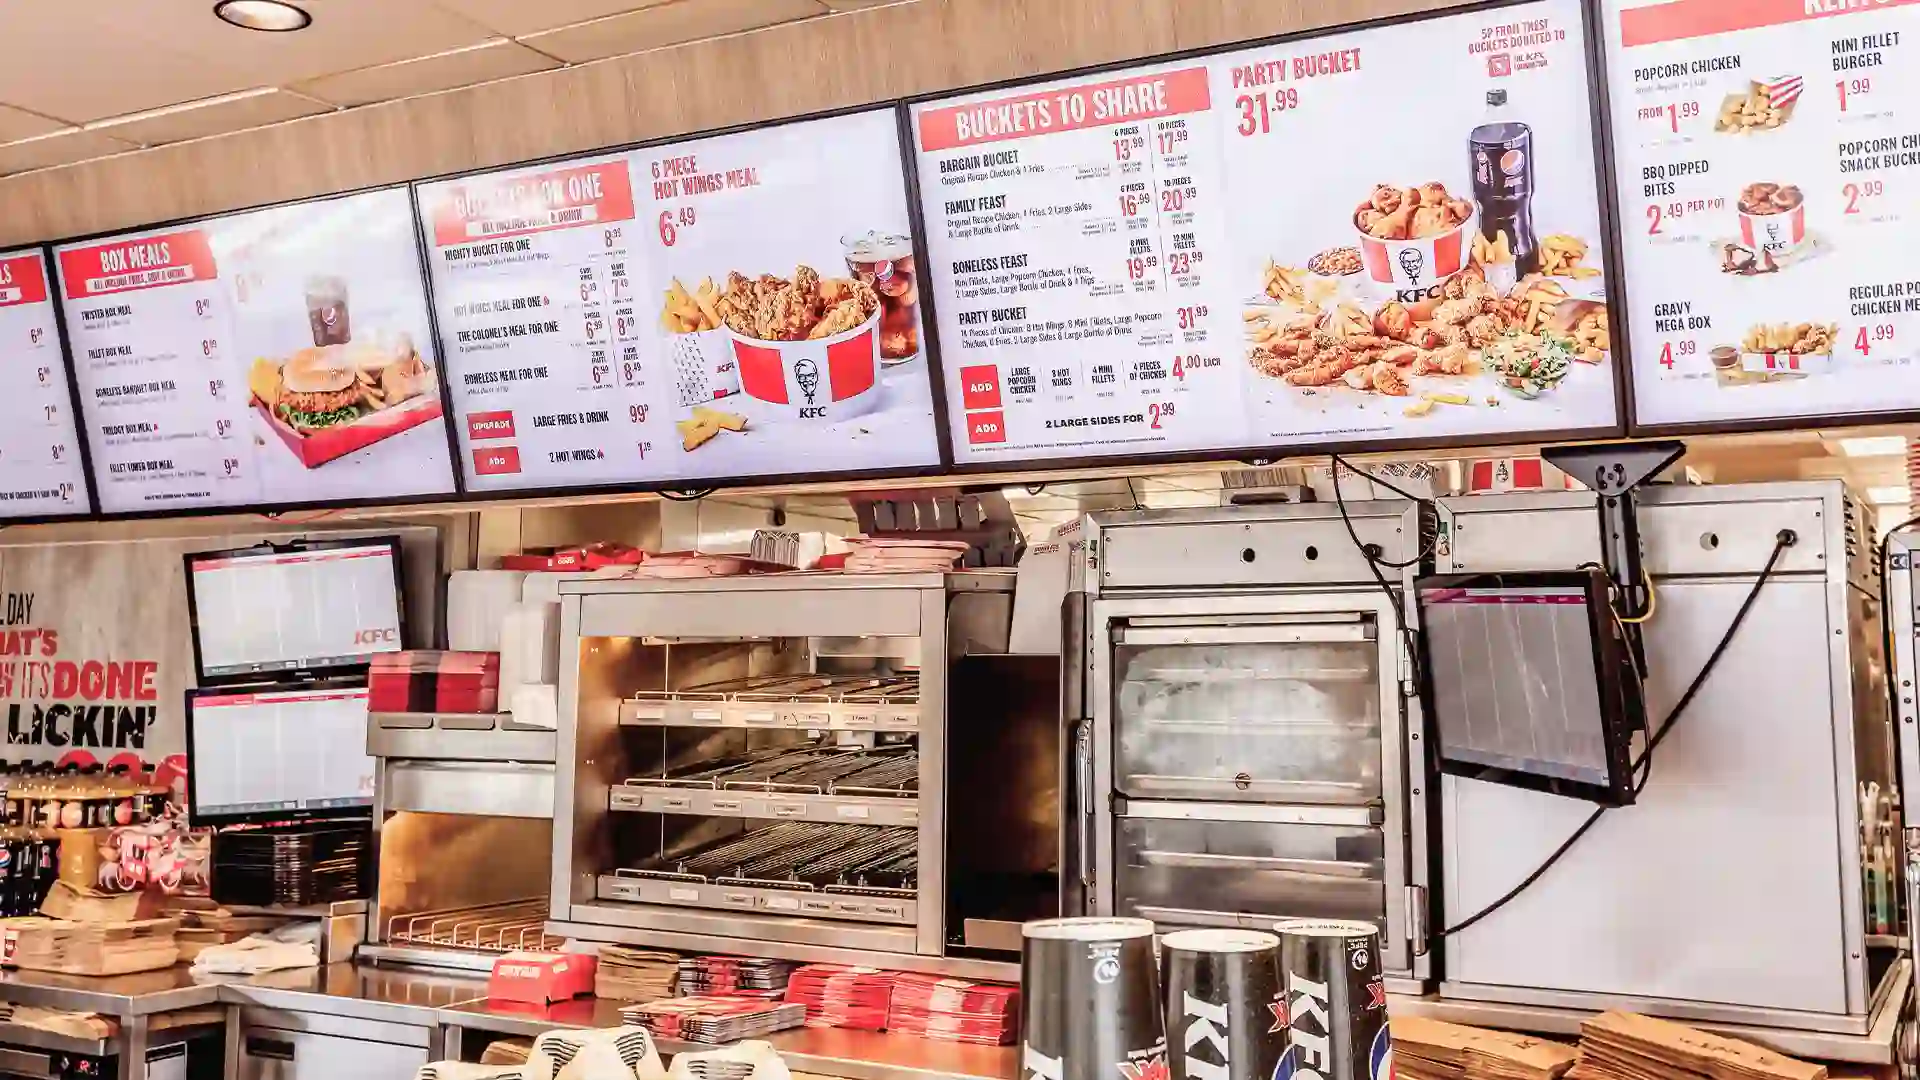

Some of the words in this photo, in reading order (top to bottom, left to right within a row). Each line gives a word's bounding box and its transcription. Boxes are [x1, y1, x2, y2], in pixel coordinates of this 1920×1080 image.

[1496, 24, 1519, 37] FROM
[1468, 38, 1509, 54] BUCKETS
[1510, 32, 1552, 48] DONATED
[1554, 30, 1565, 41] TO
[1831, 37, 1858, 54] MINI
[1862, 31, 1900, 50] FILLET
[1230, 60, 1286, 88] PARTY
[1293, 48, 1361, 80] BUCKET
[1635, 62, 1688, 82] POPCORN
[1692, 55, 1741, 74] CHICKEN
[1832, 52, 1883, 71] BURGER
[1835, 78, 1870, 111] 1.99
[956, 99, 1052, 140] BUCKETS
[1057, 94, 1086, 125] TO
[1093, 80, 1168, 119] SHARE
[1236, 88, 1298, 137] 31.99
[1638, 106, 1663, 120] FROM
[1667, 101, 1700, 133] 1.99
[1157, 122, 1165, 131] 10
[1165, 120, 1186, 130] PIECES
[1112, 137, 1144, 160] 13.99
[1157, 130, 1188, 154] 17.99
[1839, 136, 1897, 156] POPCORN
[652, 161, 660, 179] 6
[663, 155, 698, 177] PIECE
[940, 156, 980, 174] BARGAIN
[983, 150, 1019, 167] BUCKET
[1643, 165, 1665, 180] BBQ
[1668, 160, 1709, 177] DIPPED
[1840, 155, 1880, 173] SNACK
[568, 173, 604, 201] ONE
[654, 180, 678, 200] HOT
[682, 173, 723, 196] WINGS
[726, 168, 761, 189] MEAL
[1126, 183, 1145, 192] PIECES
[1172, 177, 1192, 186] PIECES
[1644, 182, 1675, 197] BITES
[945, 198, 976, 215] FAMILY
[979, 195, 1007, 211] FEAST
[1119, 193, 1150, 217] 16.99
[1162, 187, 1197, 211] 20.99
[1842, 180, 1883, 214] 2.99
[1646, 202, 1683, 235] 2.49
[1687, 200, 1705, 212] PER
[1707, 198, 1725, 210] POT
[659, 207, 696, 247] 6.49
[101, 250, 127, 273] BOX
[129, 242, 171, 268] MEALS
[445, 247, 471, 261] MIGHTY
[472, 244, 499, 257] BUCKET
[500, 241, 515, 253] FOR
[516, 239, 531, 251] ONE
[952, 258, 998, 274] BONELESS
[1000, 254, 1028, 269] FEAST
[1126, 256, 1157, 280] 19.99
[1170, 251, 1203, 274] 23.99
[1396, 285, 1441, 302] KFC
[1849, 283, 1903, 300] REGULAR
[470, 301, 491, 314] WINGS
[493, 299, 511, 312] MEAL
[512, 298, 526, 310] FOR
[528, 296, 541, 307] ONE
[1654, 301, 1691, 316] GRAVY
[1851, 299, 1901, 316] CHICKEN
[959, 310, 988, 325] PARTY
[991, 307, 1027, 321] BUCKET
[1176, 306, 1208, 329] 31.99
[1655, 317, 1684, 332] MEGA
[1688, 315, 1711, 330] BOX
[457, 330, 471, 343] THE
[472, 326, 508, 341] COLONEL'S
[509, 324, 528, 337] MEAL
[529, 322, 543, 335] FOR
[544, 321, 559, 333] ONE
[1064, 331, 1083, 341] Large
[1855, 324, 1894, 356] 4.99
[1659, 340, 1696, 370] 4.99
[464, 372, 499, 385] BONELESS
[499, 370, 517, 383] MEAL
[519, 367, 533, 380] FOR
[534, 366, 549, 378] ONE
[1011, 366, 1031, 377] LARGE
[1057, 368, 1070, 377] HOT
[1098, 365, 1113, 374] MINI
[1129, 372, 1138, 381] OF
[1139, 369, 1167, 380] CHICKEN
[1139, 361, 1161, 371] PIECES
[1172, 354, 1201, 381] 4.00
[1204, 357, 1221, 368] EACH
[970, 382, 993, 393] ADD
[1008, 375, 1037, 386] POPCORN
[1052, 377, 1072, 387] WINGS
[1092, 374, 1116, 384] FILLETS
[1009, 385, 1036, 394] CHICKEN
[533, 415, 556, 428] LARGE
[558, 413, 577, 426] FRIES
[579, 412, 584, 424] &
[586, 411, 609, 424] DRINK
[800, 406, 827, 419] KFC
[1045, 420, 1052, 428] 2
[1054, 418, 1088, 428] LARGE
[1091, 416, 1120, 425] SIDES
[1123, 414, 1144, 423] FOR
[1148, 402, 1175, 429] 2.99
[126, 424, 137, 434] BOX
[138, 422, 153, 433] MEAL
[976, 423, 998, 433] ADD
[550, 453, 555, 463] 2
[556, 451, 570, 462] HOT
[572, 450, 595, 461] WINGS
[7, 592, 35, 625] DAY
[354, 628, 396, 645] KFC
[52, 660, 158, 701] DONE
[7, 703, 157, 748] LICKIN'
